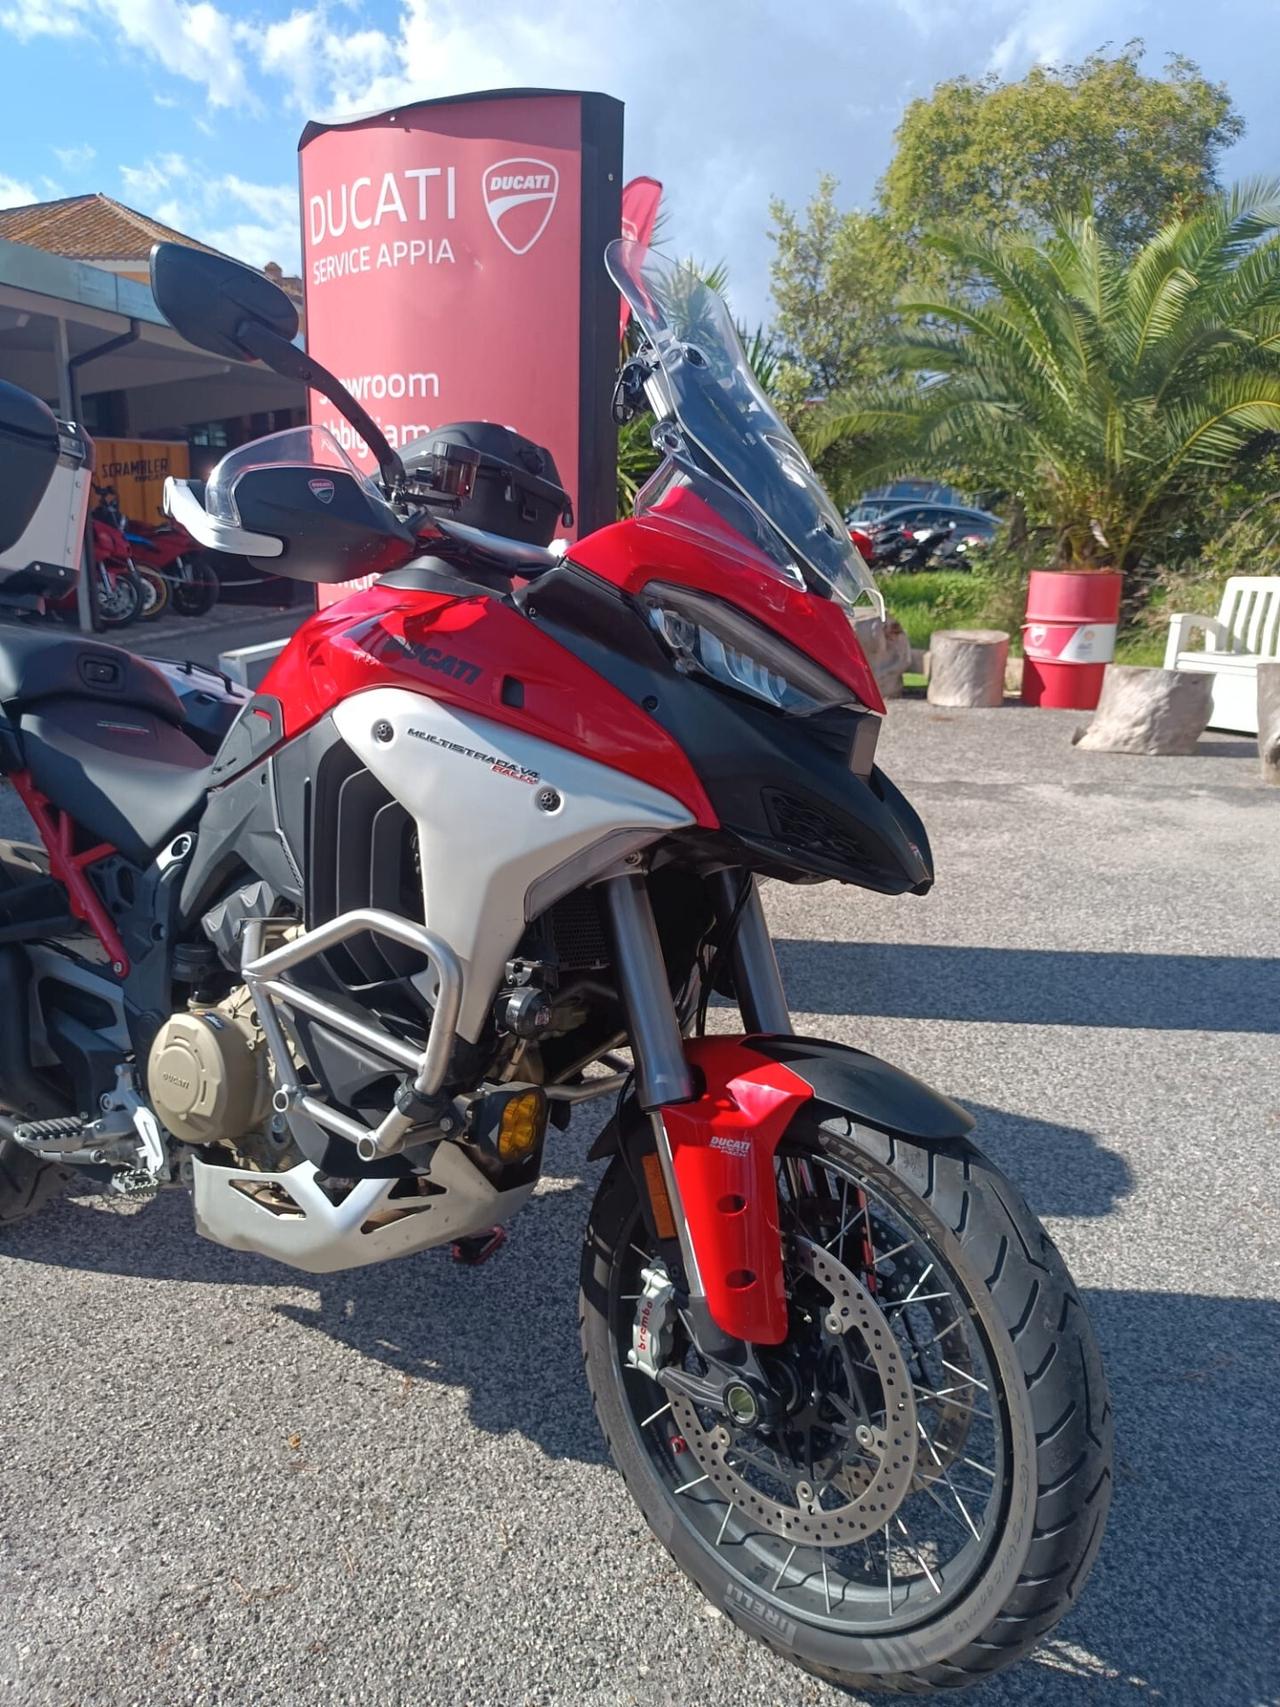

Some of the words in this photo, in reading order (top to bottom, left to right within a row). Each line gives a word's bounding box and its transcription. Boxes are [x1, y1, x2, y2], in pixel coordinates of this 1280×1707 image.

[490, 174, 550, 191] DUCATI
[310, 166, 456, 246] DUCATI
[313, 245, 371, 285] SERVICE
[377, 238, 455, 269] APPIA
[102, 458, 169, 479] SCRAMBLER
[407, 728, 517, 772] MULTISTRADA
[710, 1136, 751, 1151] DUCATI
[638, 1301, 653, 1351] brembo
